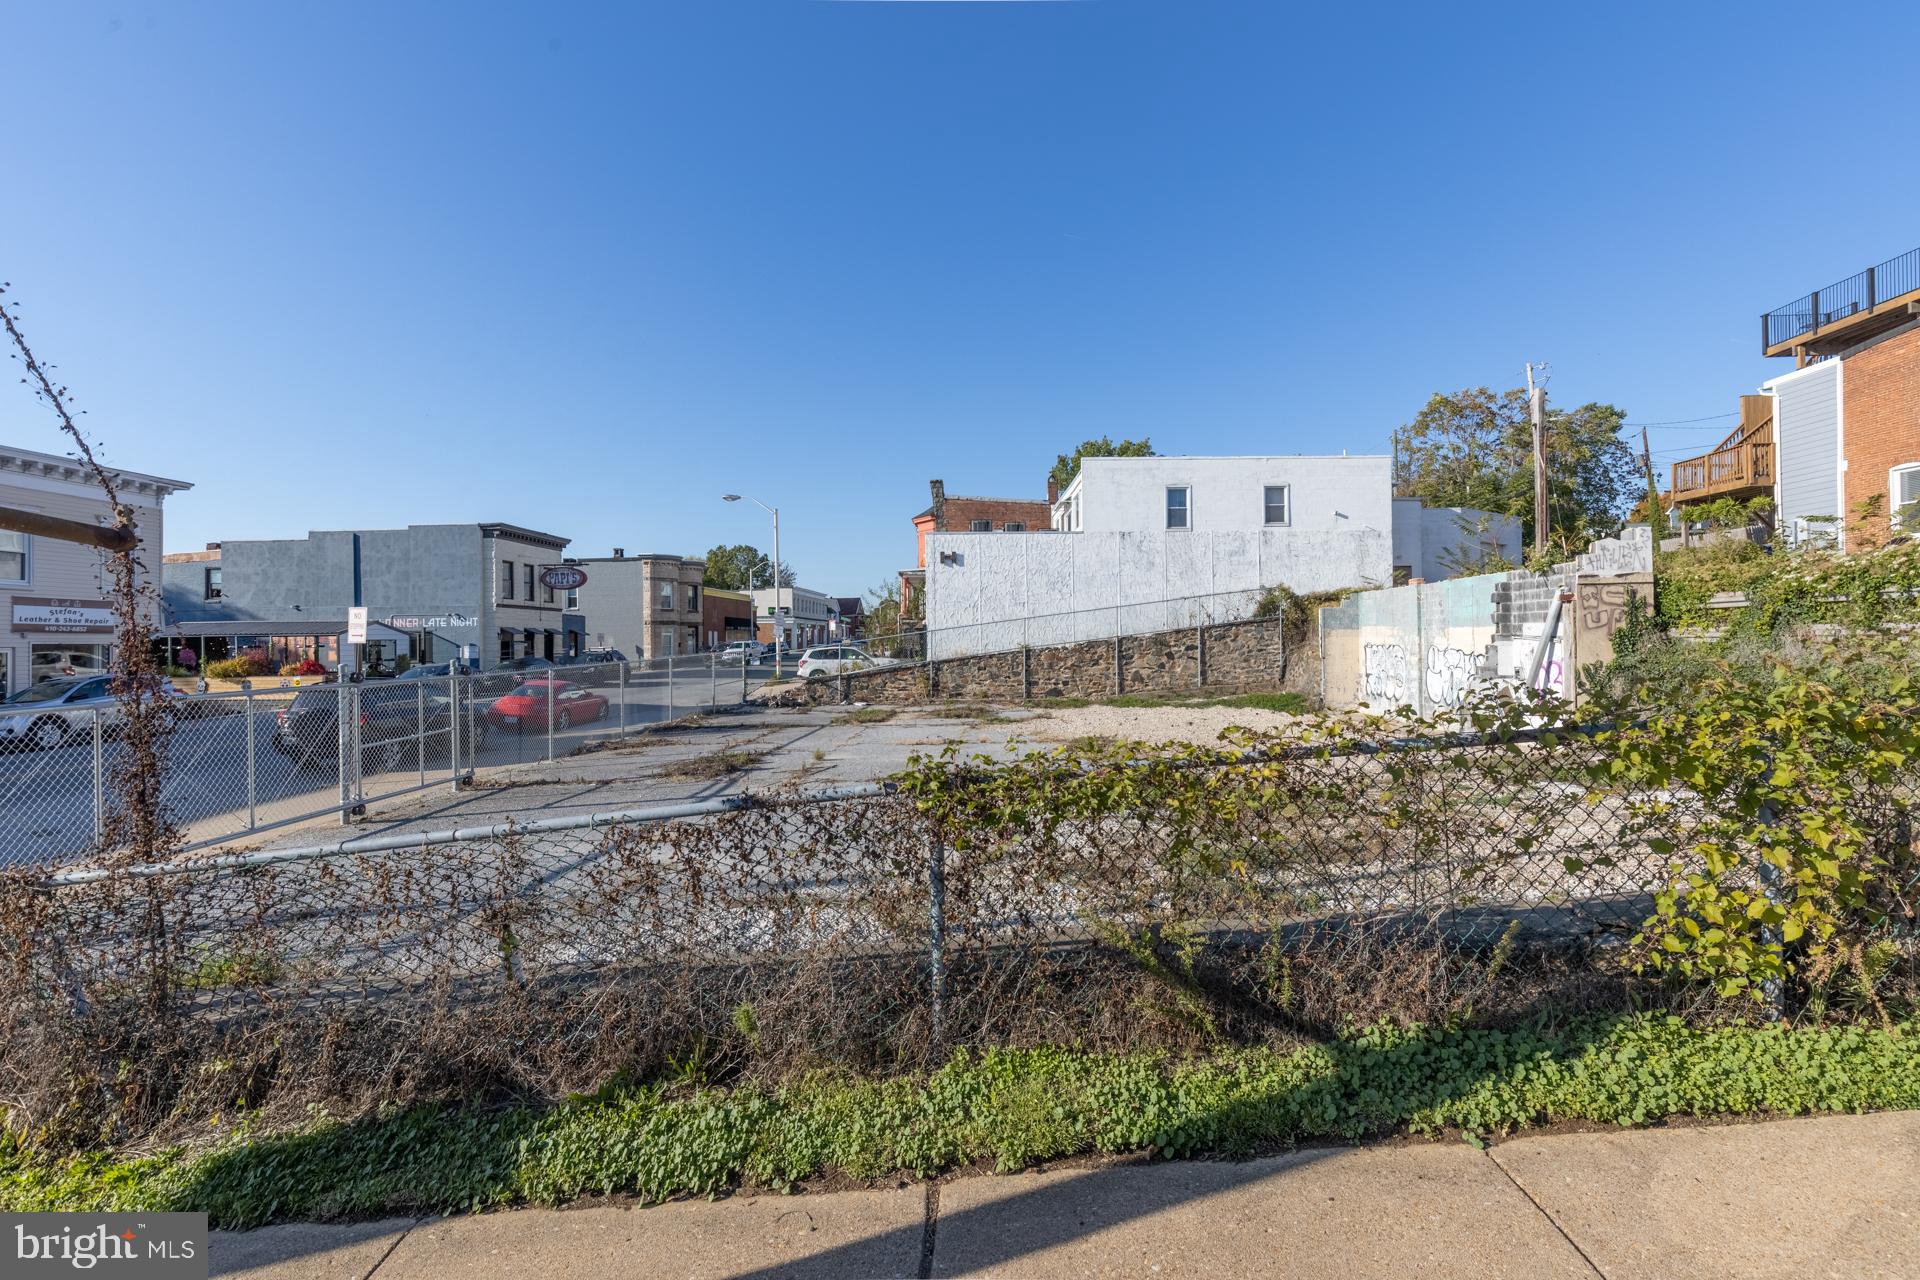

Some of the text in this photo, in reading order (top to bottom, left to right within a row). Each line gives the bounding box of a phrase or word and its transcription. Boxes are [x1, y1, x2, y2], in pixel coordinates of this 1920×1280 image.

[548, 572, 577, 584] PAPI'S
[49, 608, 84, 618] Stefan's
[385, 618, 419, 628] DNNER
[422, 618, 447, 627] LATE
